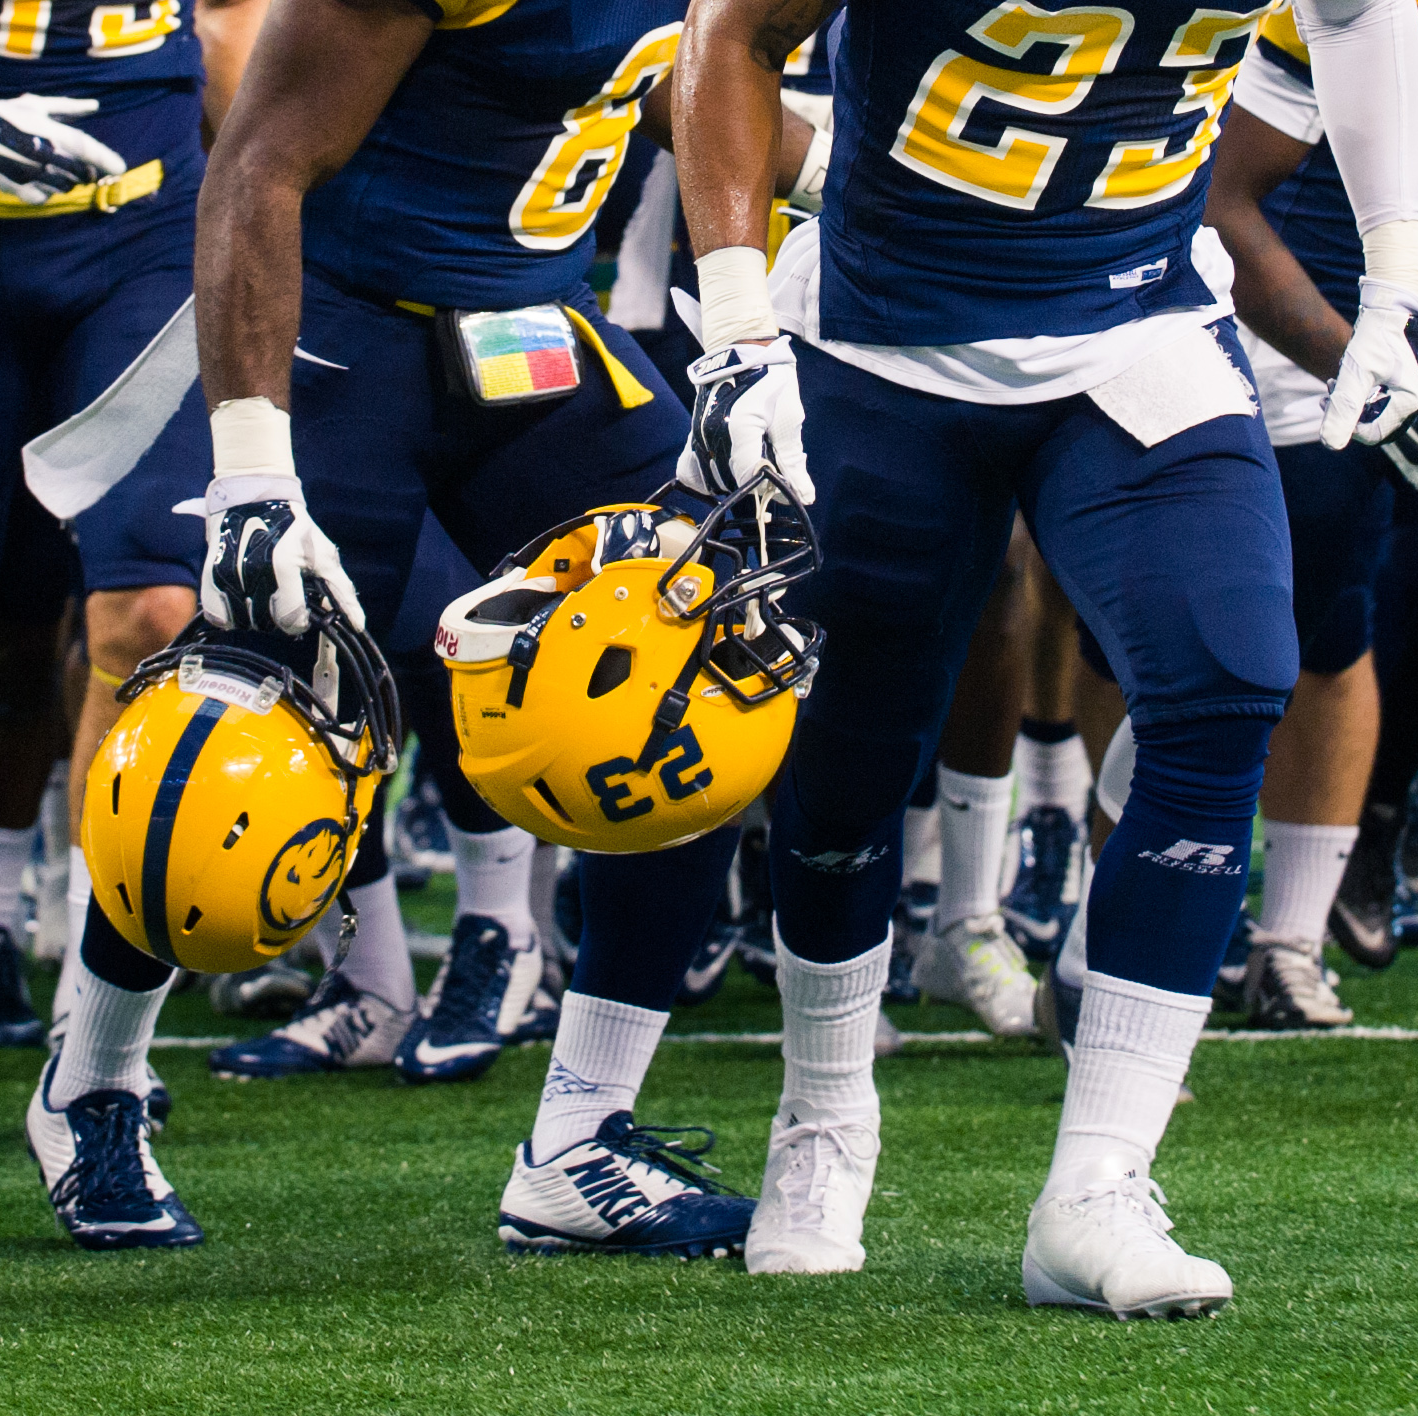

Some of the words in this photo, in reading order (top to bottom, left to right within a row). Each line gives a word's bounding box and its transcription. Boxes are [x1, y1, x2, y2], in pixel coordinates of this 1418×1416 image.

[509, 21, 685, 251] 8
[194, 680, 252, 704] Riddell
[585, 723, 713, 822] 23
[563, 1154, 652, 1230] NIKE
